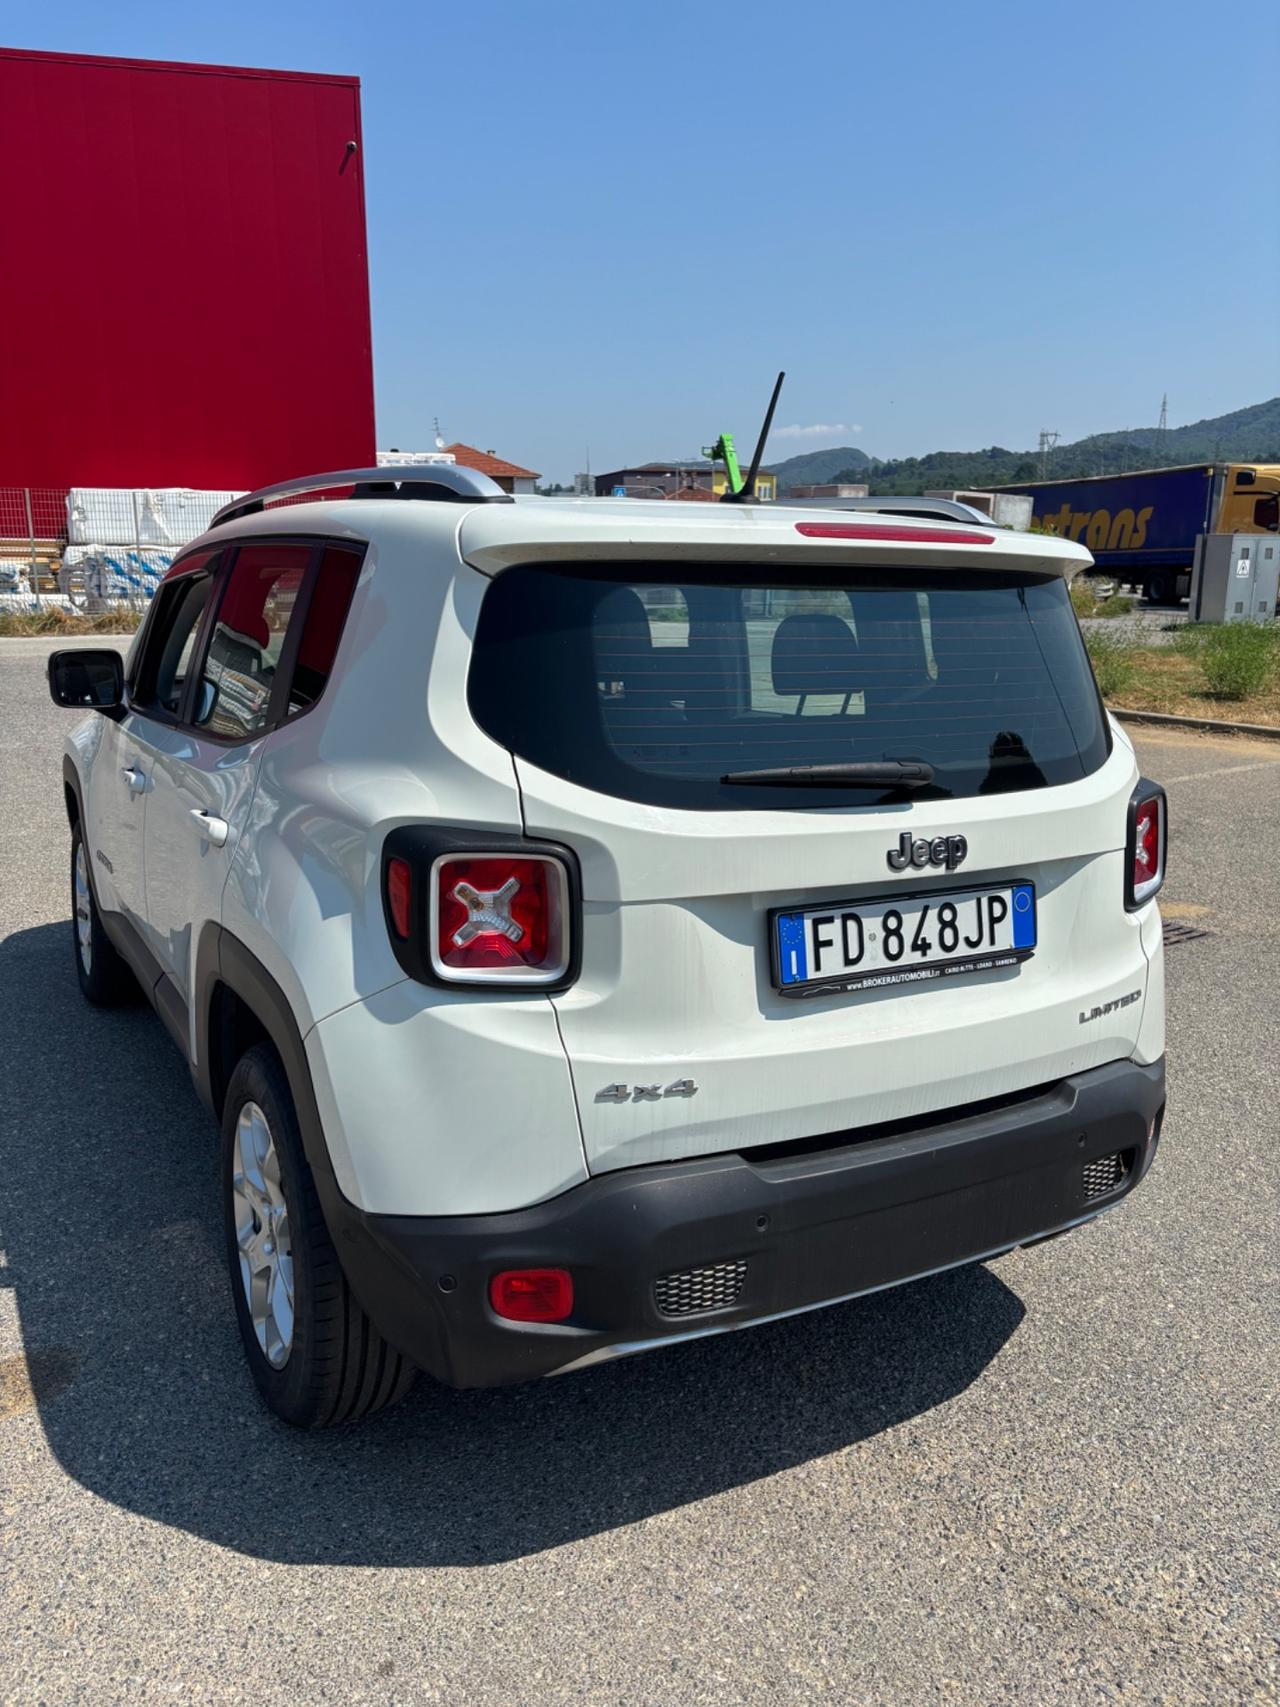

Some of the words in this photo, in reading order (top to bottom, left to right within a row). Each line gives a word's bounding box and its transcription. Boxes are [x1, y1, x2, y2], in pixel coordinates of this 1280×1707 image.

[886, 832, 968, 871] Jeep
[812, 912, 865, 972] FD
[881, 894, 1008, 962] 848JP
